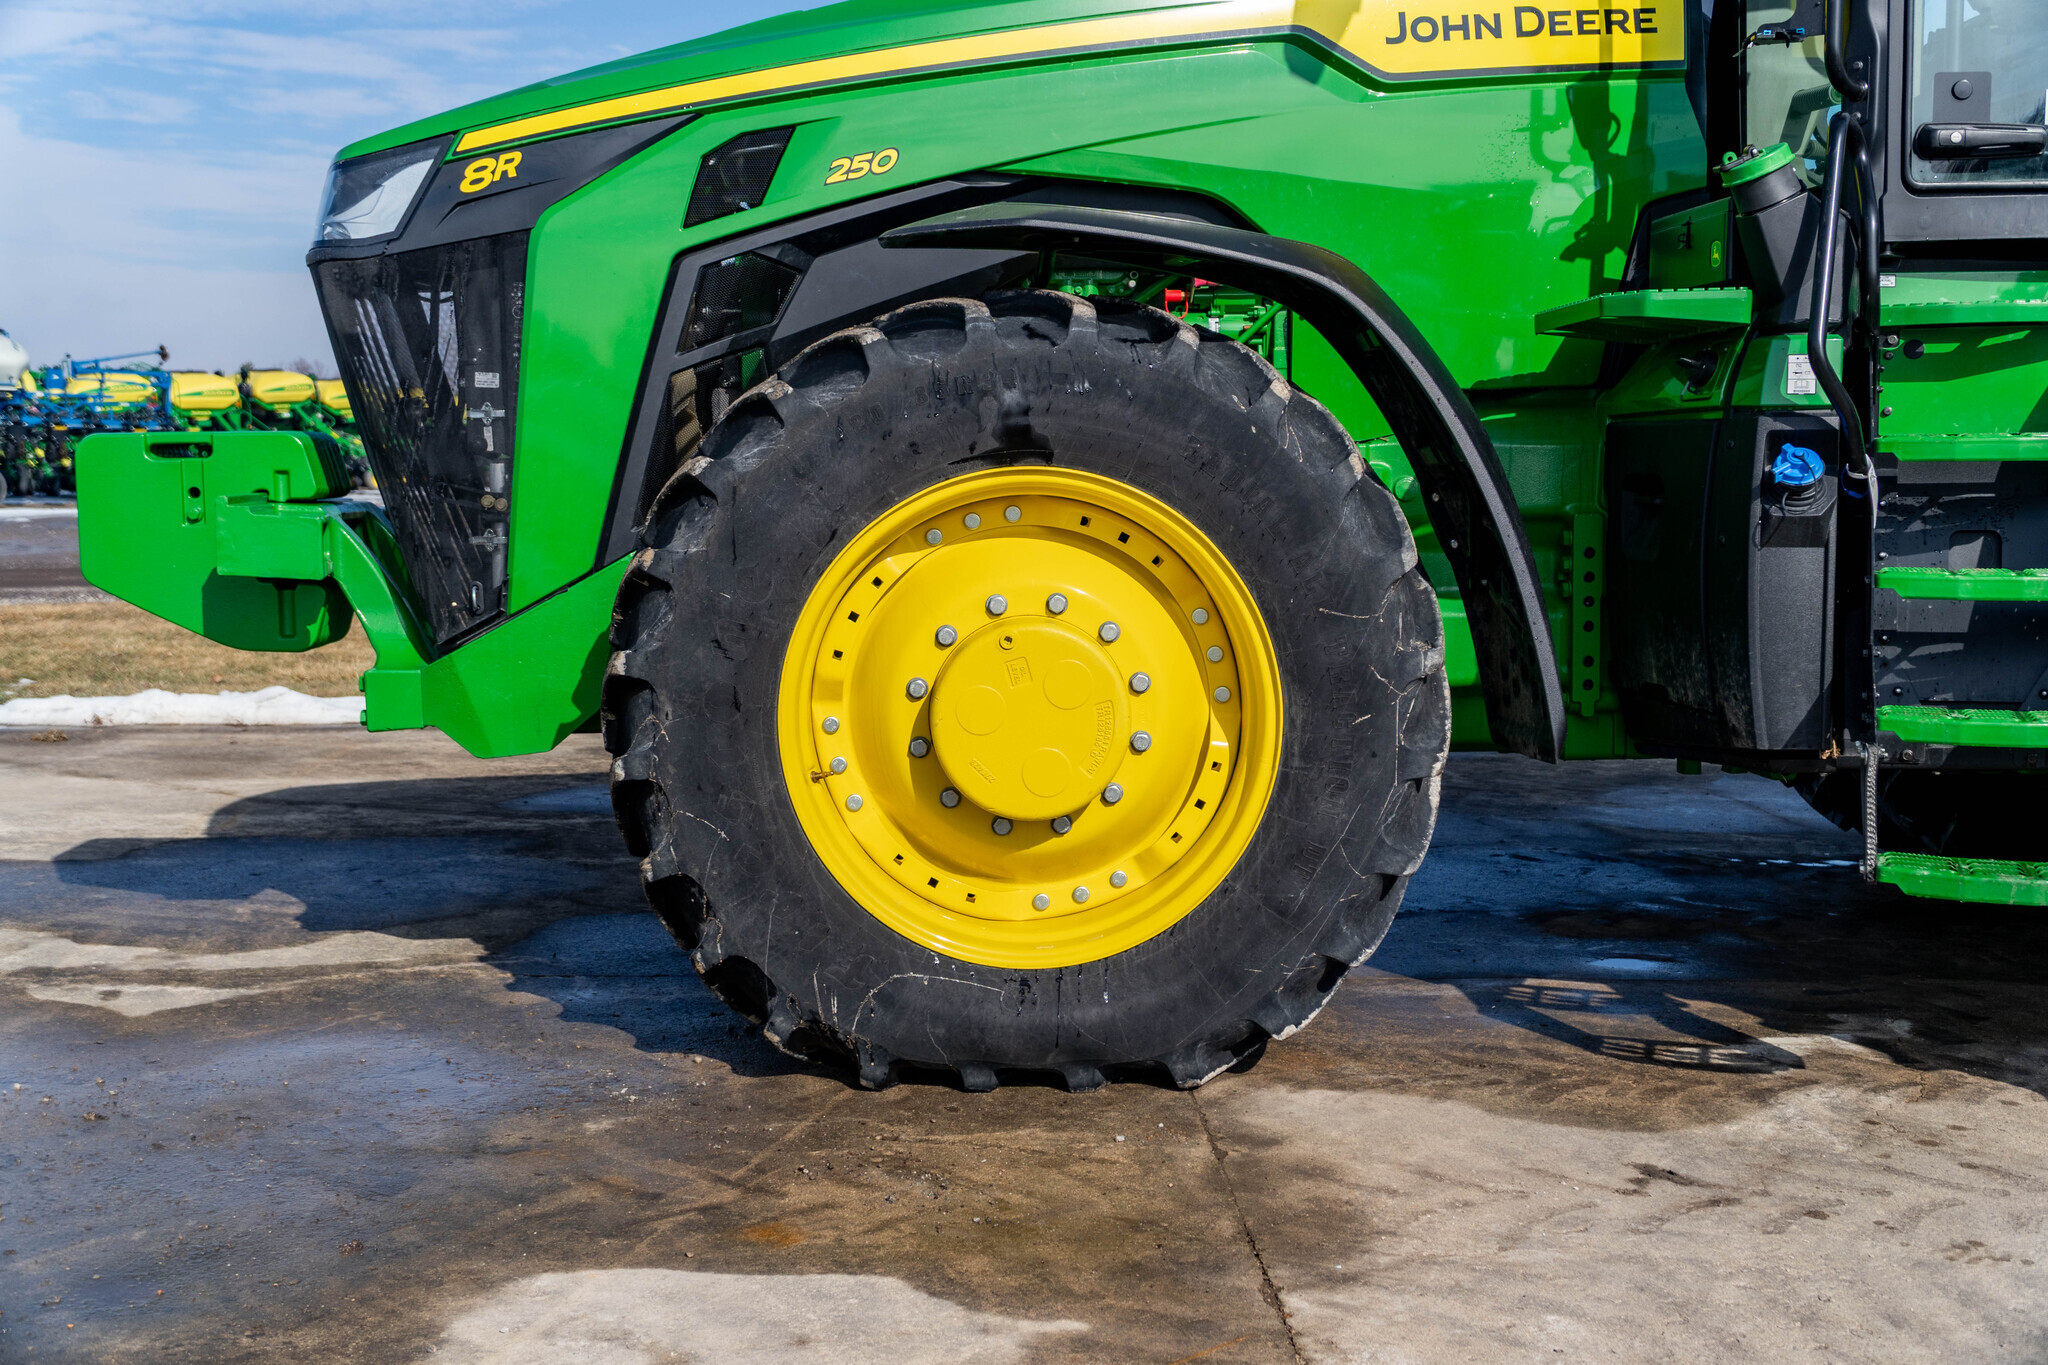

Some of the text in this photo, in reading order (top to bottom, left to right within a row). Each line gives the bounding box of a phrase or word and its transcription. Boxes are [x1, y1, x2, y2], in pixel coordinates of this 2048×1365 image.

[1386, 6, 1658, 45] JOHN DEERE
[459, 151, 523, 193] 8R
[824, 147, 900, 186] 250
